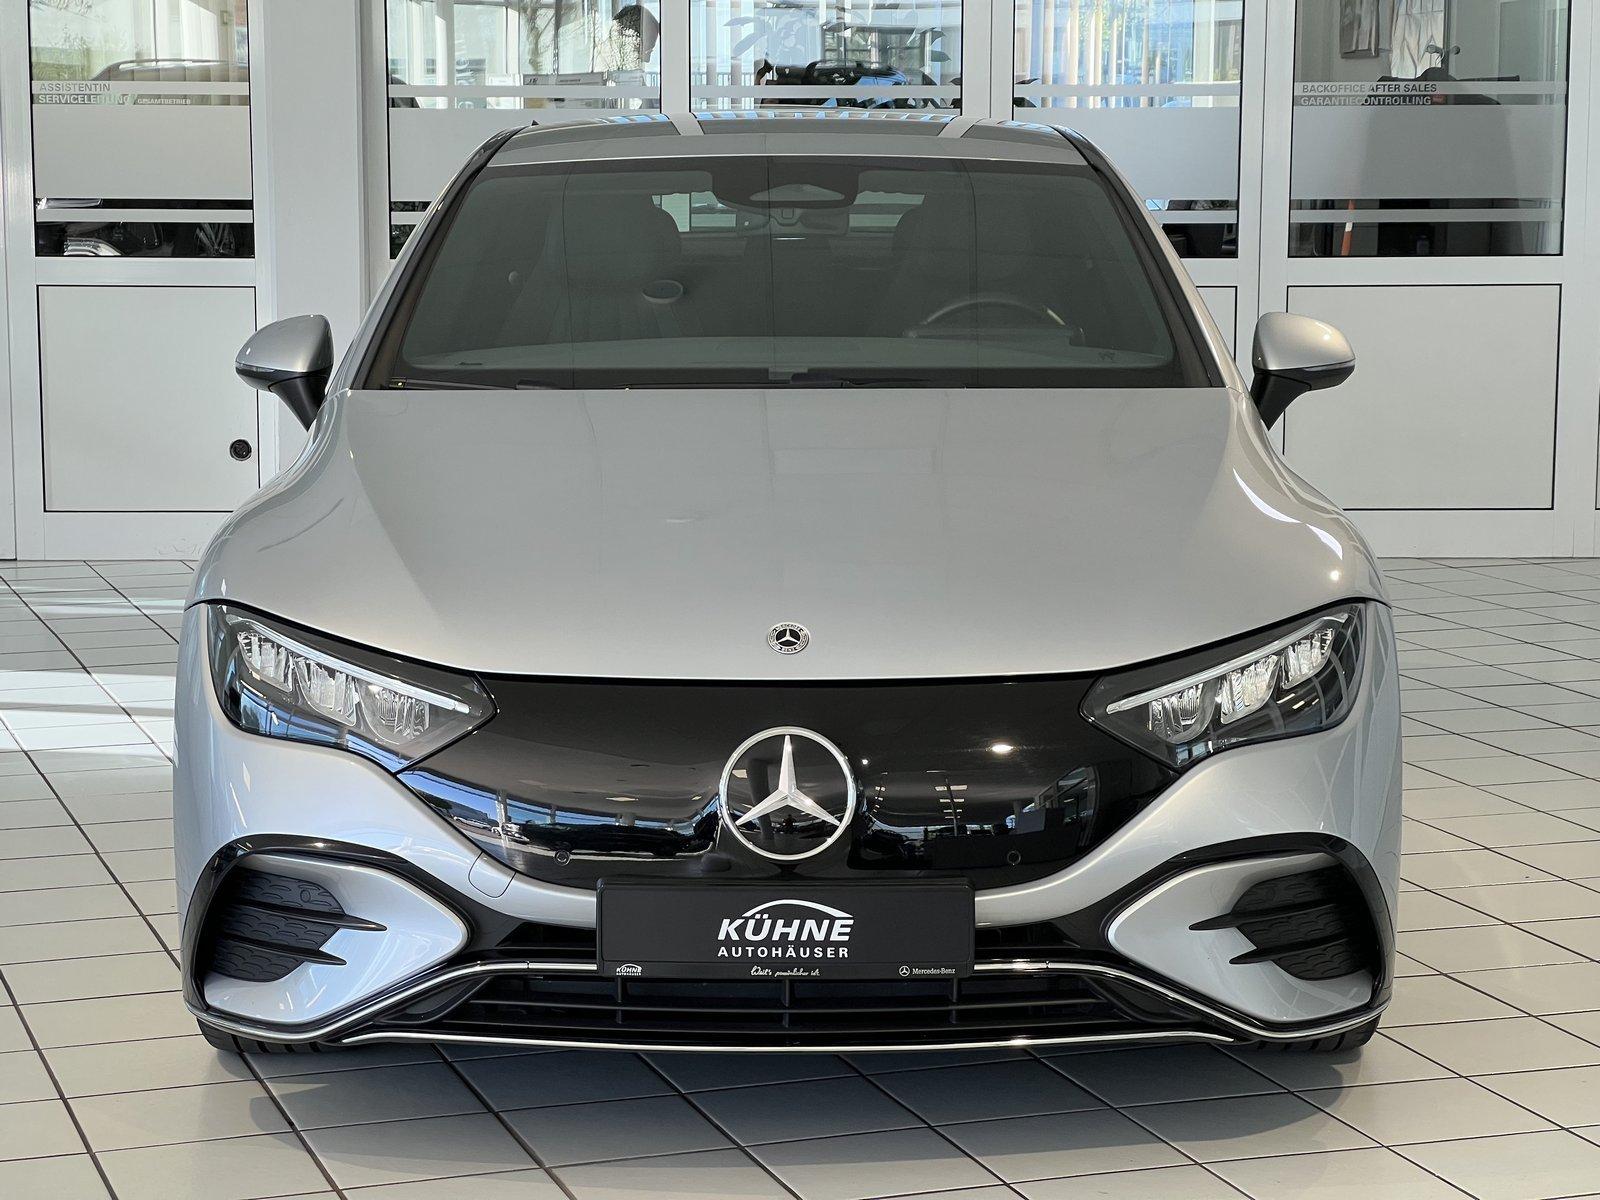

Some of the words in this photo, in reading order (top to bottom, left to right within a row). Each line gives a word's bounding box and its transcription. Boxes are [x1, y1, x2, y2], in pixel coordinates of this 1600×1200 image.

[40, 83, 110, 92] ASSISTENTIN
[1302, 84, 1366, 93] BACKOFFICE
[1369, 83, 1400, 92] AFTER
[1403, 83, 1437, 92] SALES
[1301, 96, 1432, 106] GARANTIECONTROLLING
[717, 913, 855, 941] KÜHNE
[717, 944, 849, 958] AUTOHÄUSER
[912, 967, 956, 975] Mercedes-Benz
